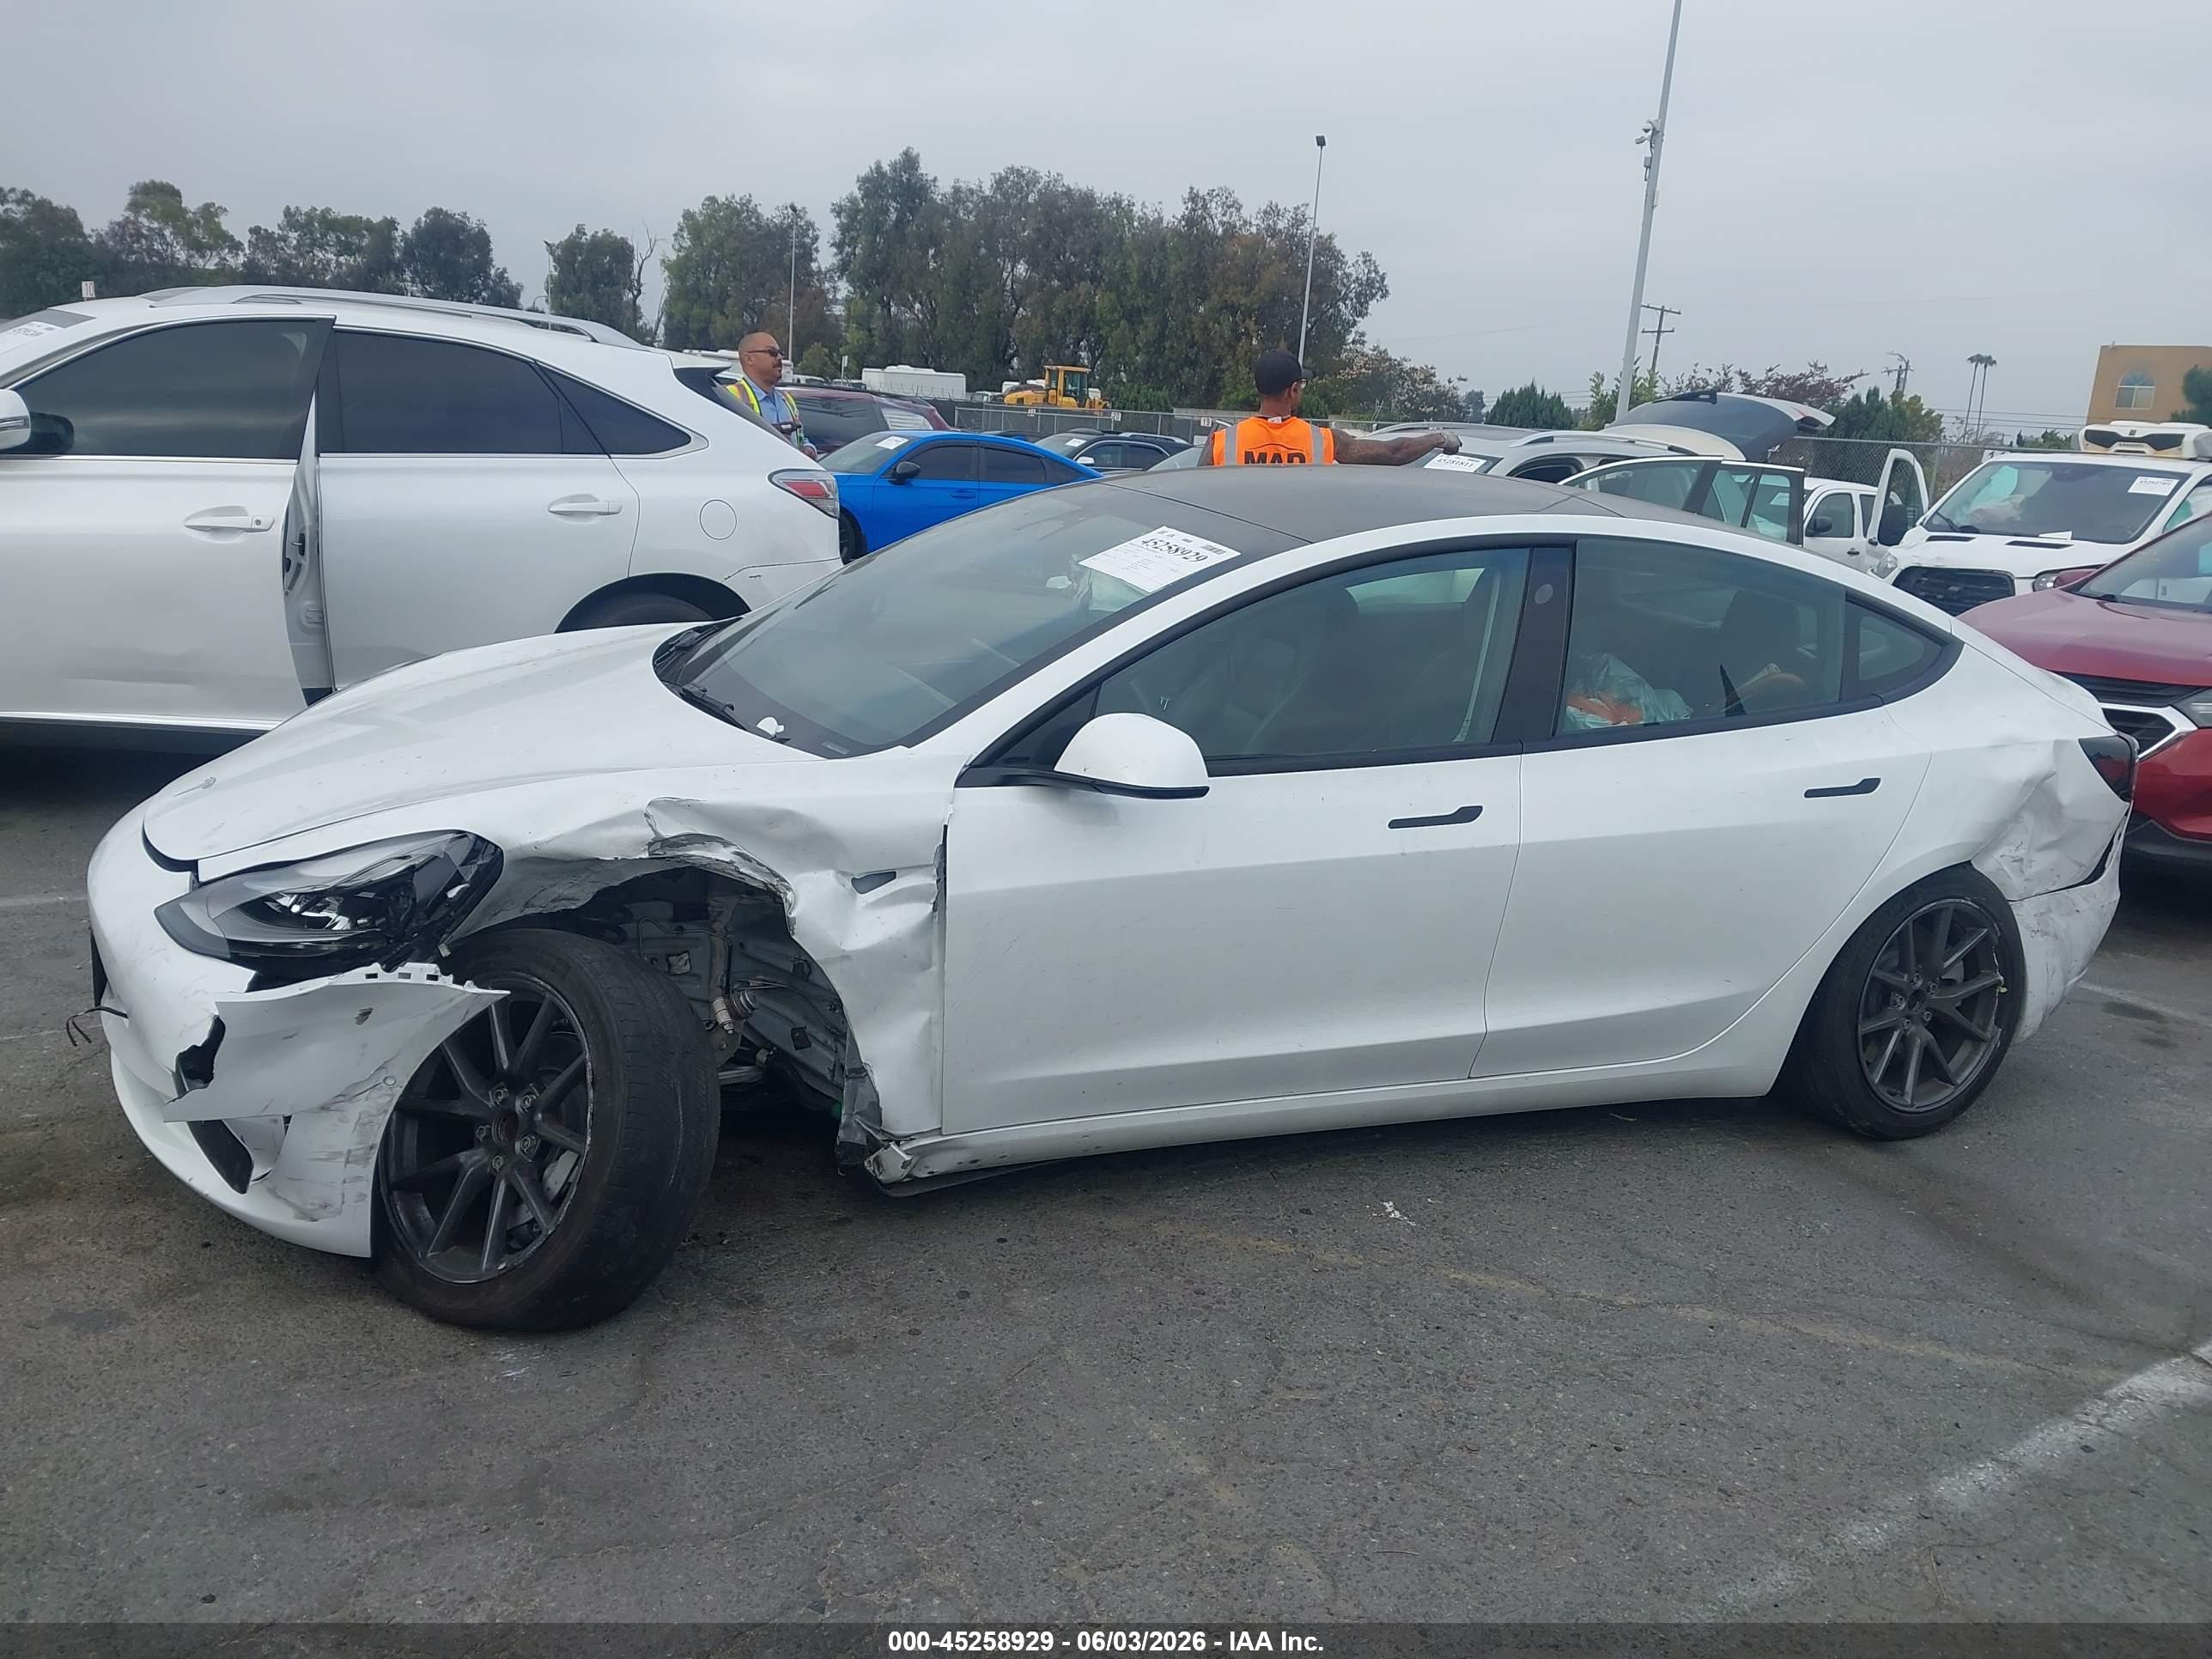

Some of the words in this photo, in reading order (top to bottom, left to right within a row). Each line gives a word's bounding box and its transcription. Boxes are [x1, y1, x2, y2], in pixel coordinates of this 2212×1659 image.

[84, 281, 94, 296] 10
[1201, 416, 1212, 426] 19
[1140, 538, 1208, 562] 45258929
